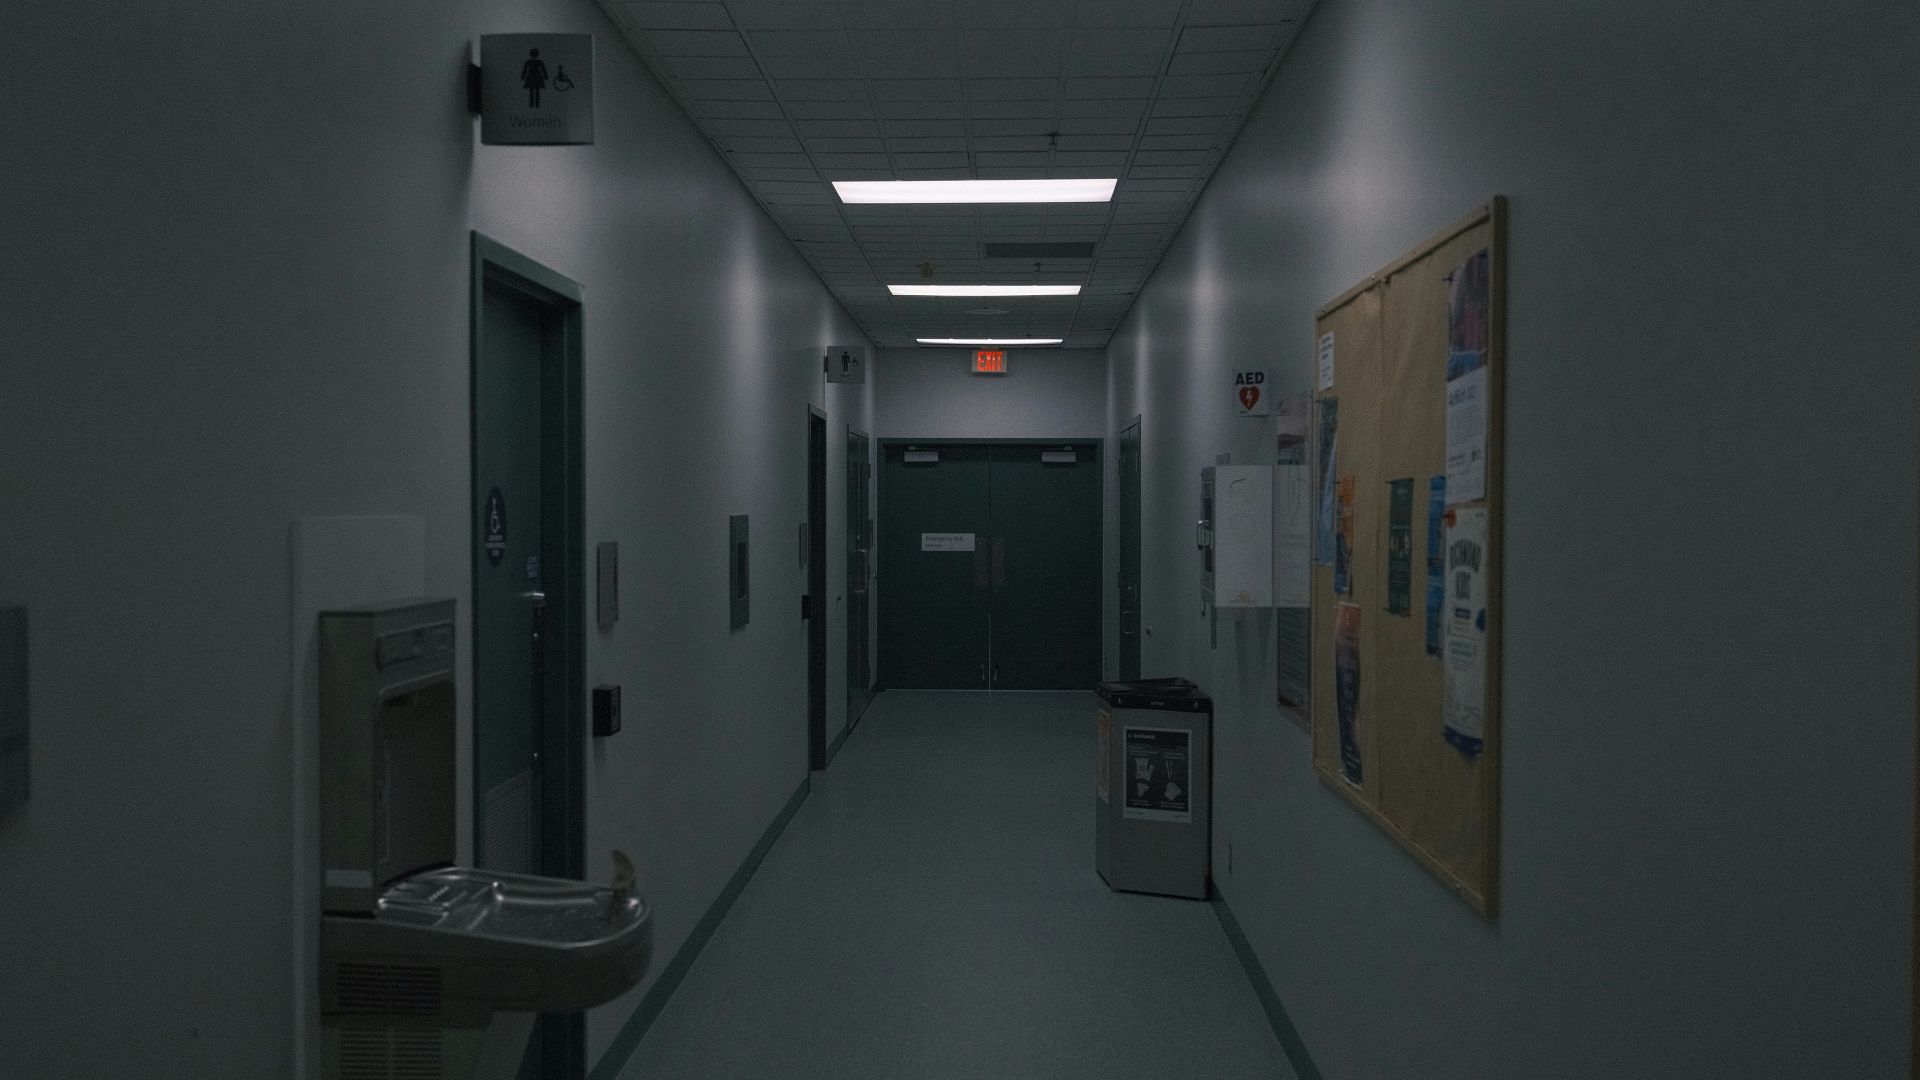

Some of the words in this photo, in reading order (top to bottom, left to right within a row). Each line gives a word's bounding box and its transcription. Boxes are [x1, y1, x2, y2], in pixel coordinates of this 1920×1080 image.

[509, 115, 561, 128] Women
[977, 351, 1003, 371] EXIT
[1235, 371, 1265, 386] AED
